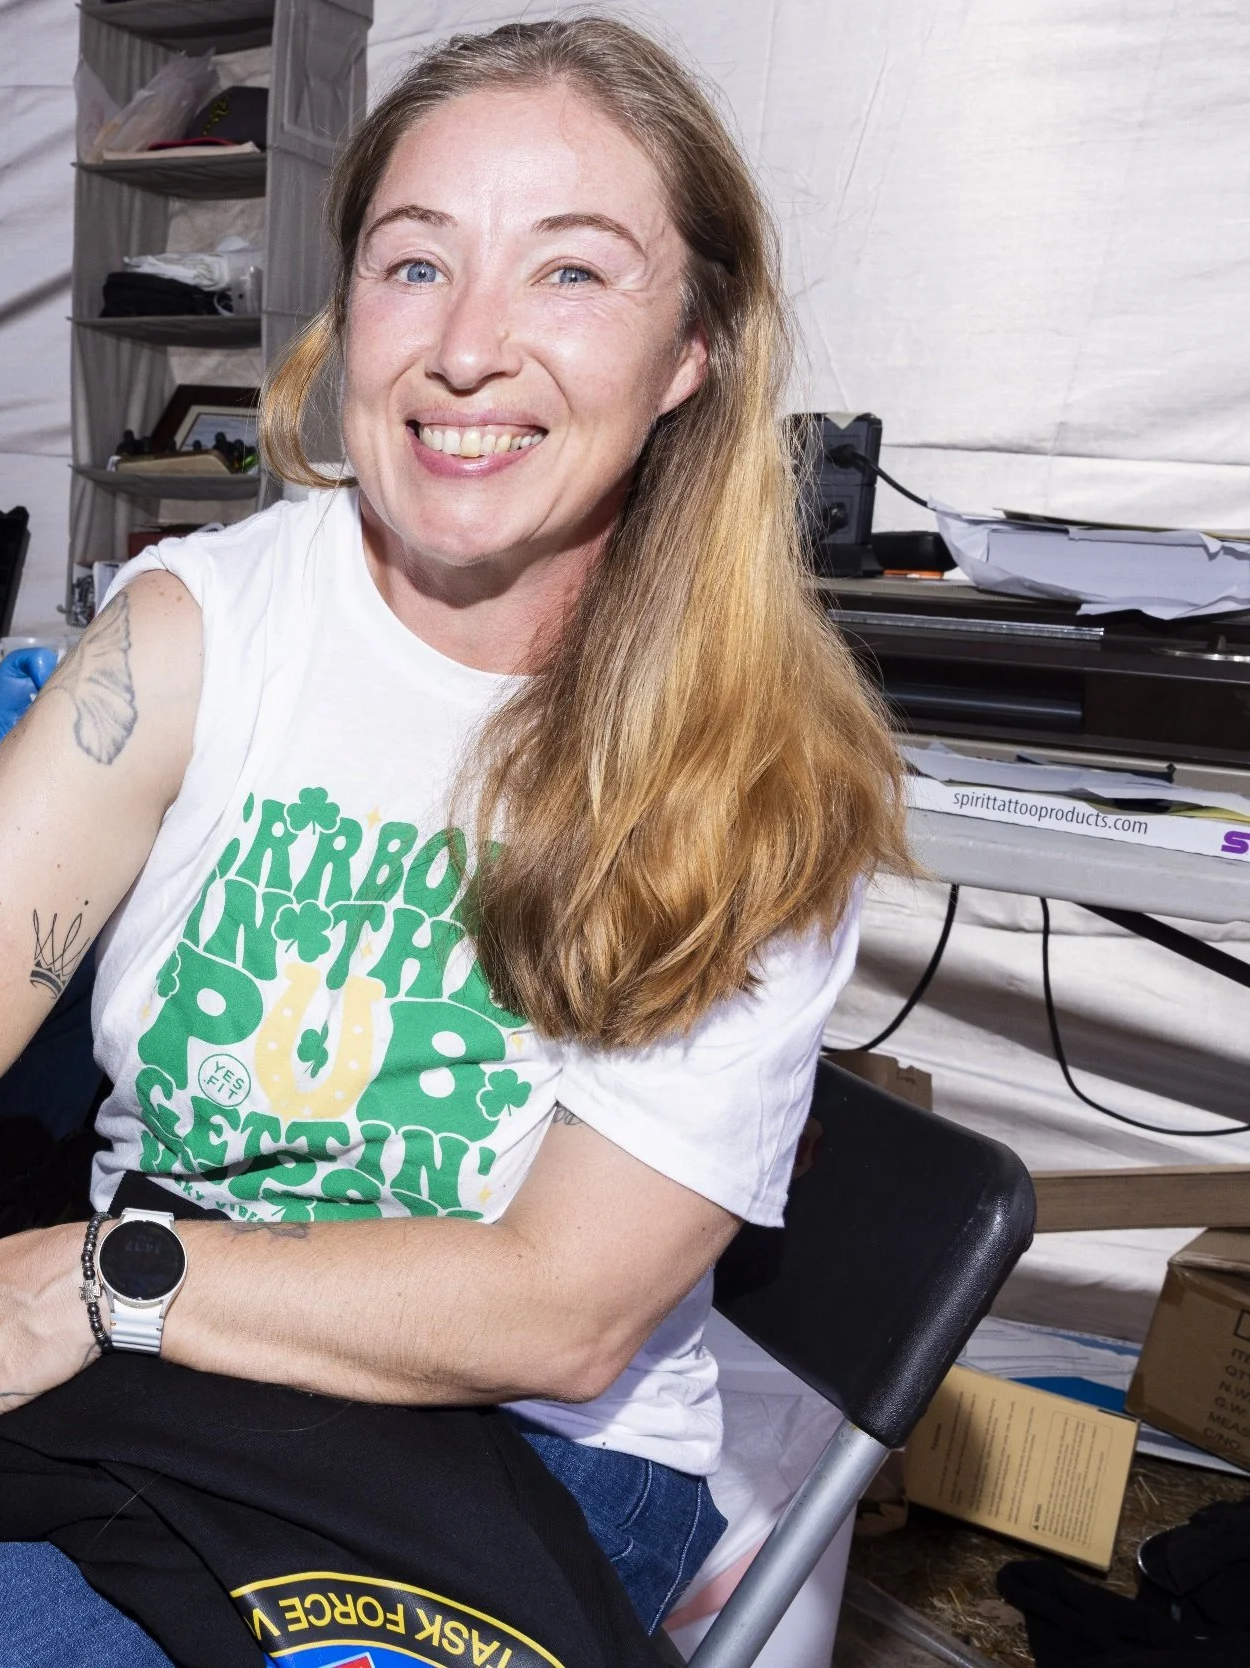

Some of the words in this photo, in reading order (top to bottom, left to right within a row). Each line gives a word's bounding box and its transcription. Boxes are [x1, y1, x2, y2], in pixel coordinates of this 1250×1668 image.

[952, 791, 1149, 835] spirittattooproducts.com
[214, 1061, 245, 1091] YES
[278, 1592, 406, 1635] FORCE
